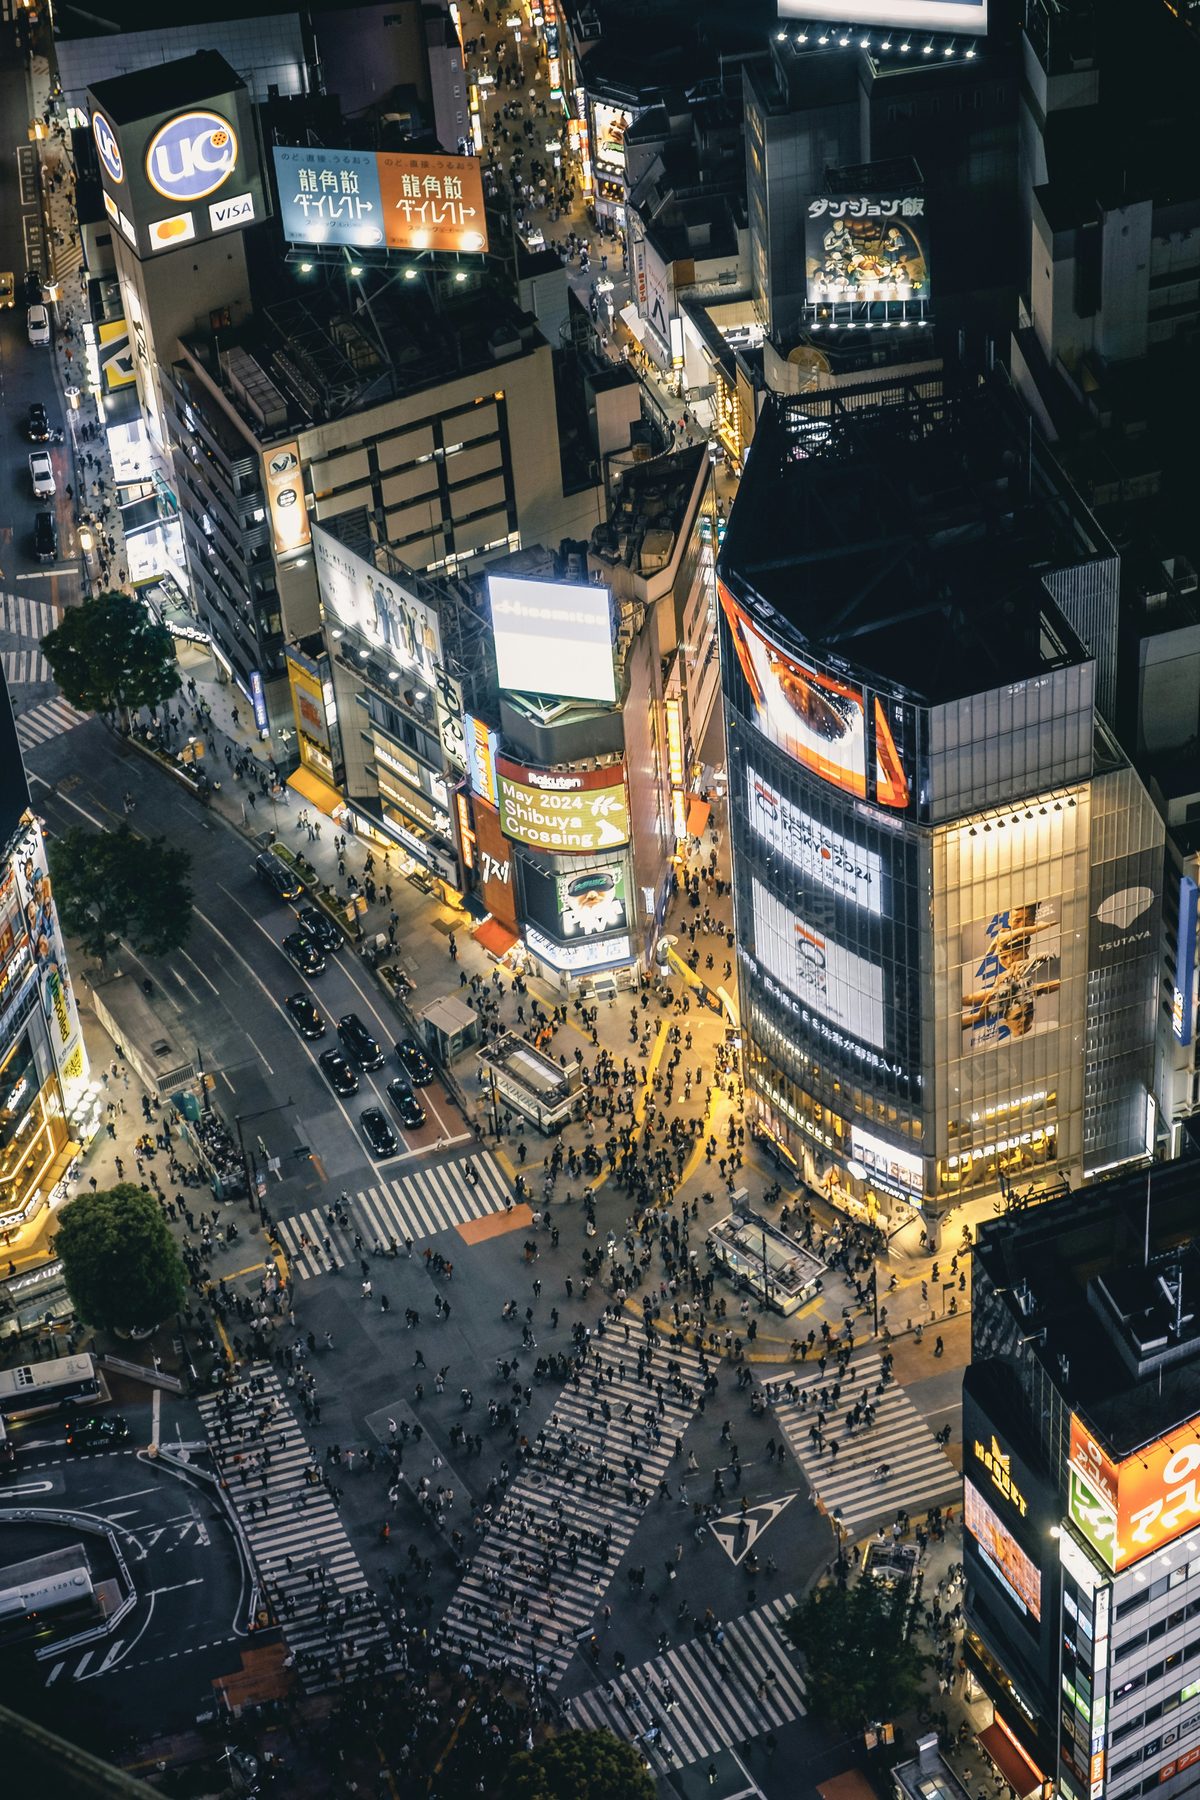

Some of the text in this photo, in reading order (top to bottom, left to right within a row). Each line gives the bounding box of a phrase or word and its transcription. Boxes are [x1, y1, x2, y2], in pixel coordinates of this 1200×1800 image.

[155, 127, 229, 183] UC
[298, 168, 360, 194] 龍角散
[401, 174, 463, 199] 龍角散
[215, 202, 251, 222] VISA
[293, 194, 373, 219] ダイレクト
[395, 199, 476, 225] ダイレクト
[808, 197, 925, 218] ダンジョン飯
[528, 772, 581, 787] Rakuten
[502, 781, 583, 809] May 2024
[504, 799, 582, 830] Shibuya
[506, 816, 593, 847] Crossing
[1098, 930, 1151, 952] TSUTAYA
[757, 1074, 833, 1147] STARBUCKS
[948, 1125, 1055, 1168] STARBUCKS
[1130, 1478, 1200, 1543] アコ
